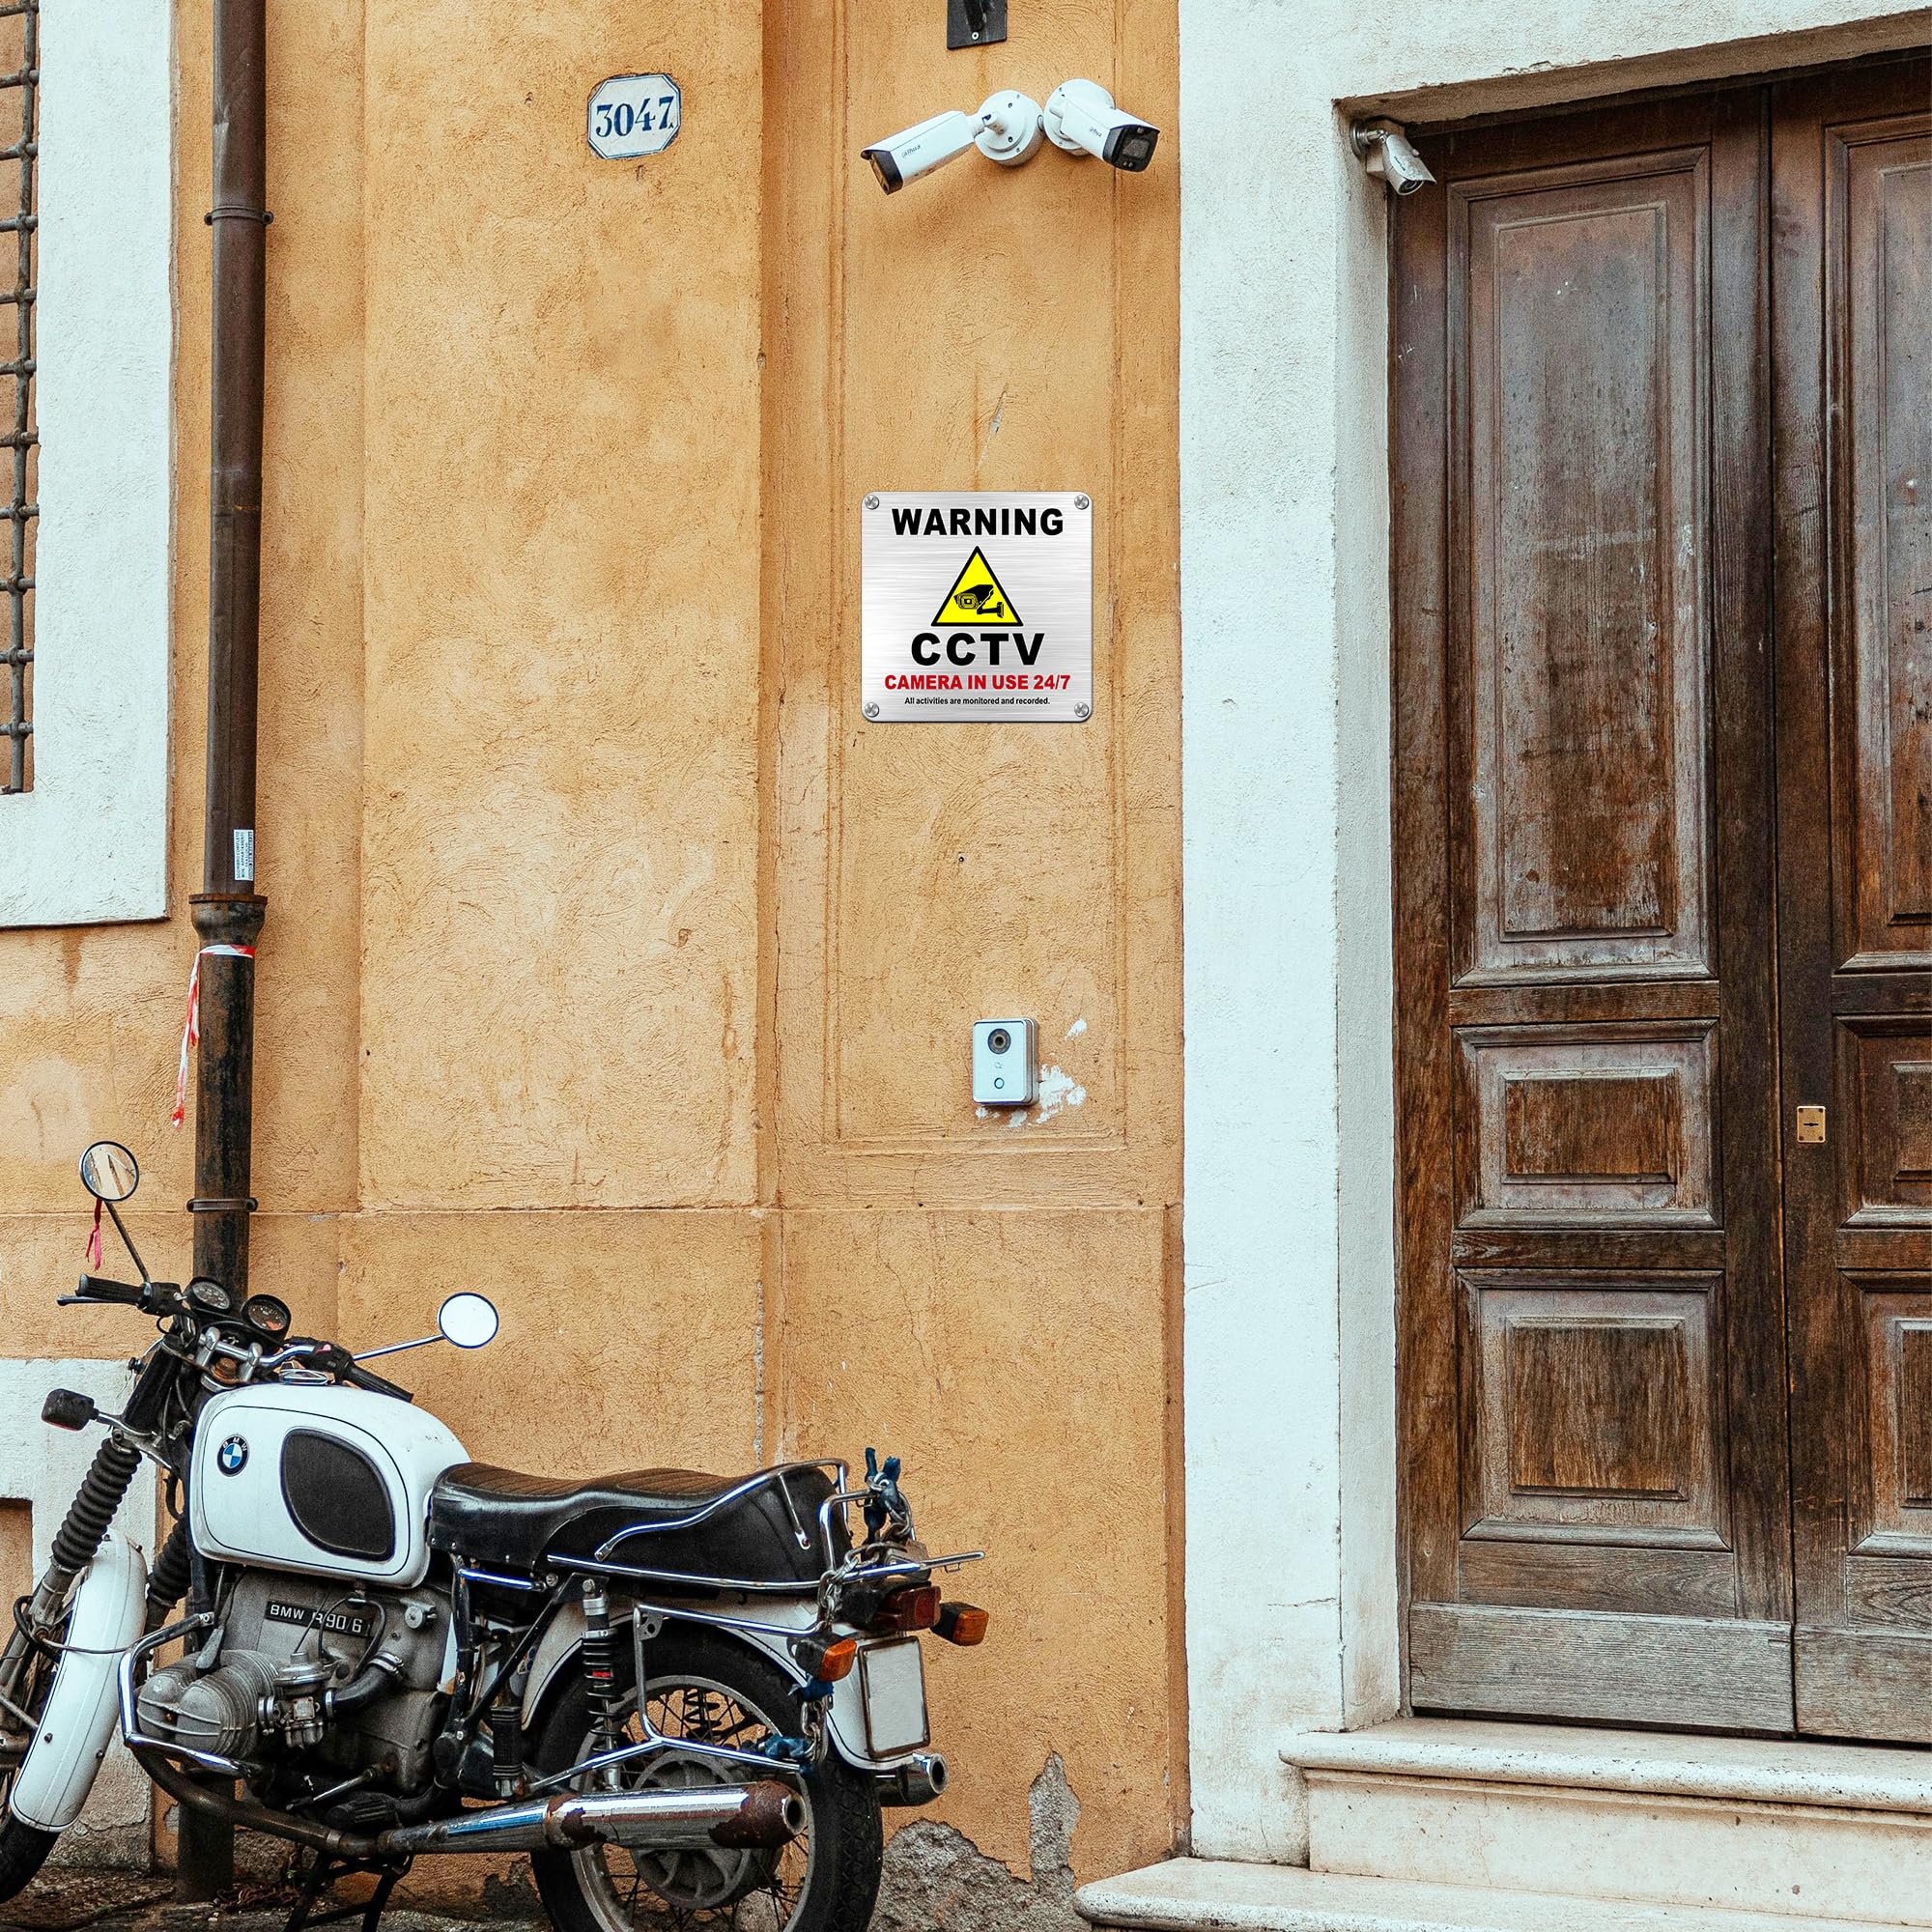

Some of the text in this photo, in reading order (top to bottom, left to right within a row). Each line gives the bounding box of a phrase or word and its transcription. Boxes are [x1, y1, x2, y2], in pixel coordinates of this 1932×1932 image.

[892, 508, 1064, 535] WARNING
[911, 633, 1045, 666] CCTV
[884, 674, 1071, 690] CAMERA IN USE 24/7
[222, 1436, 247, 1451] BMW
[270, 1605, 304, 1620] BMW
